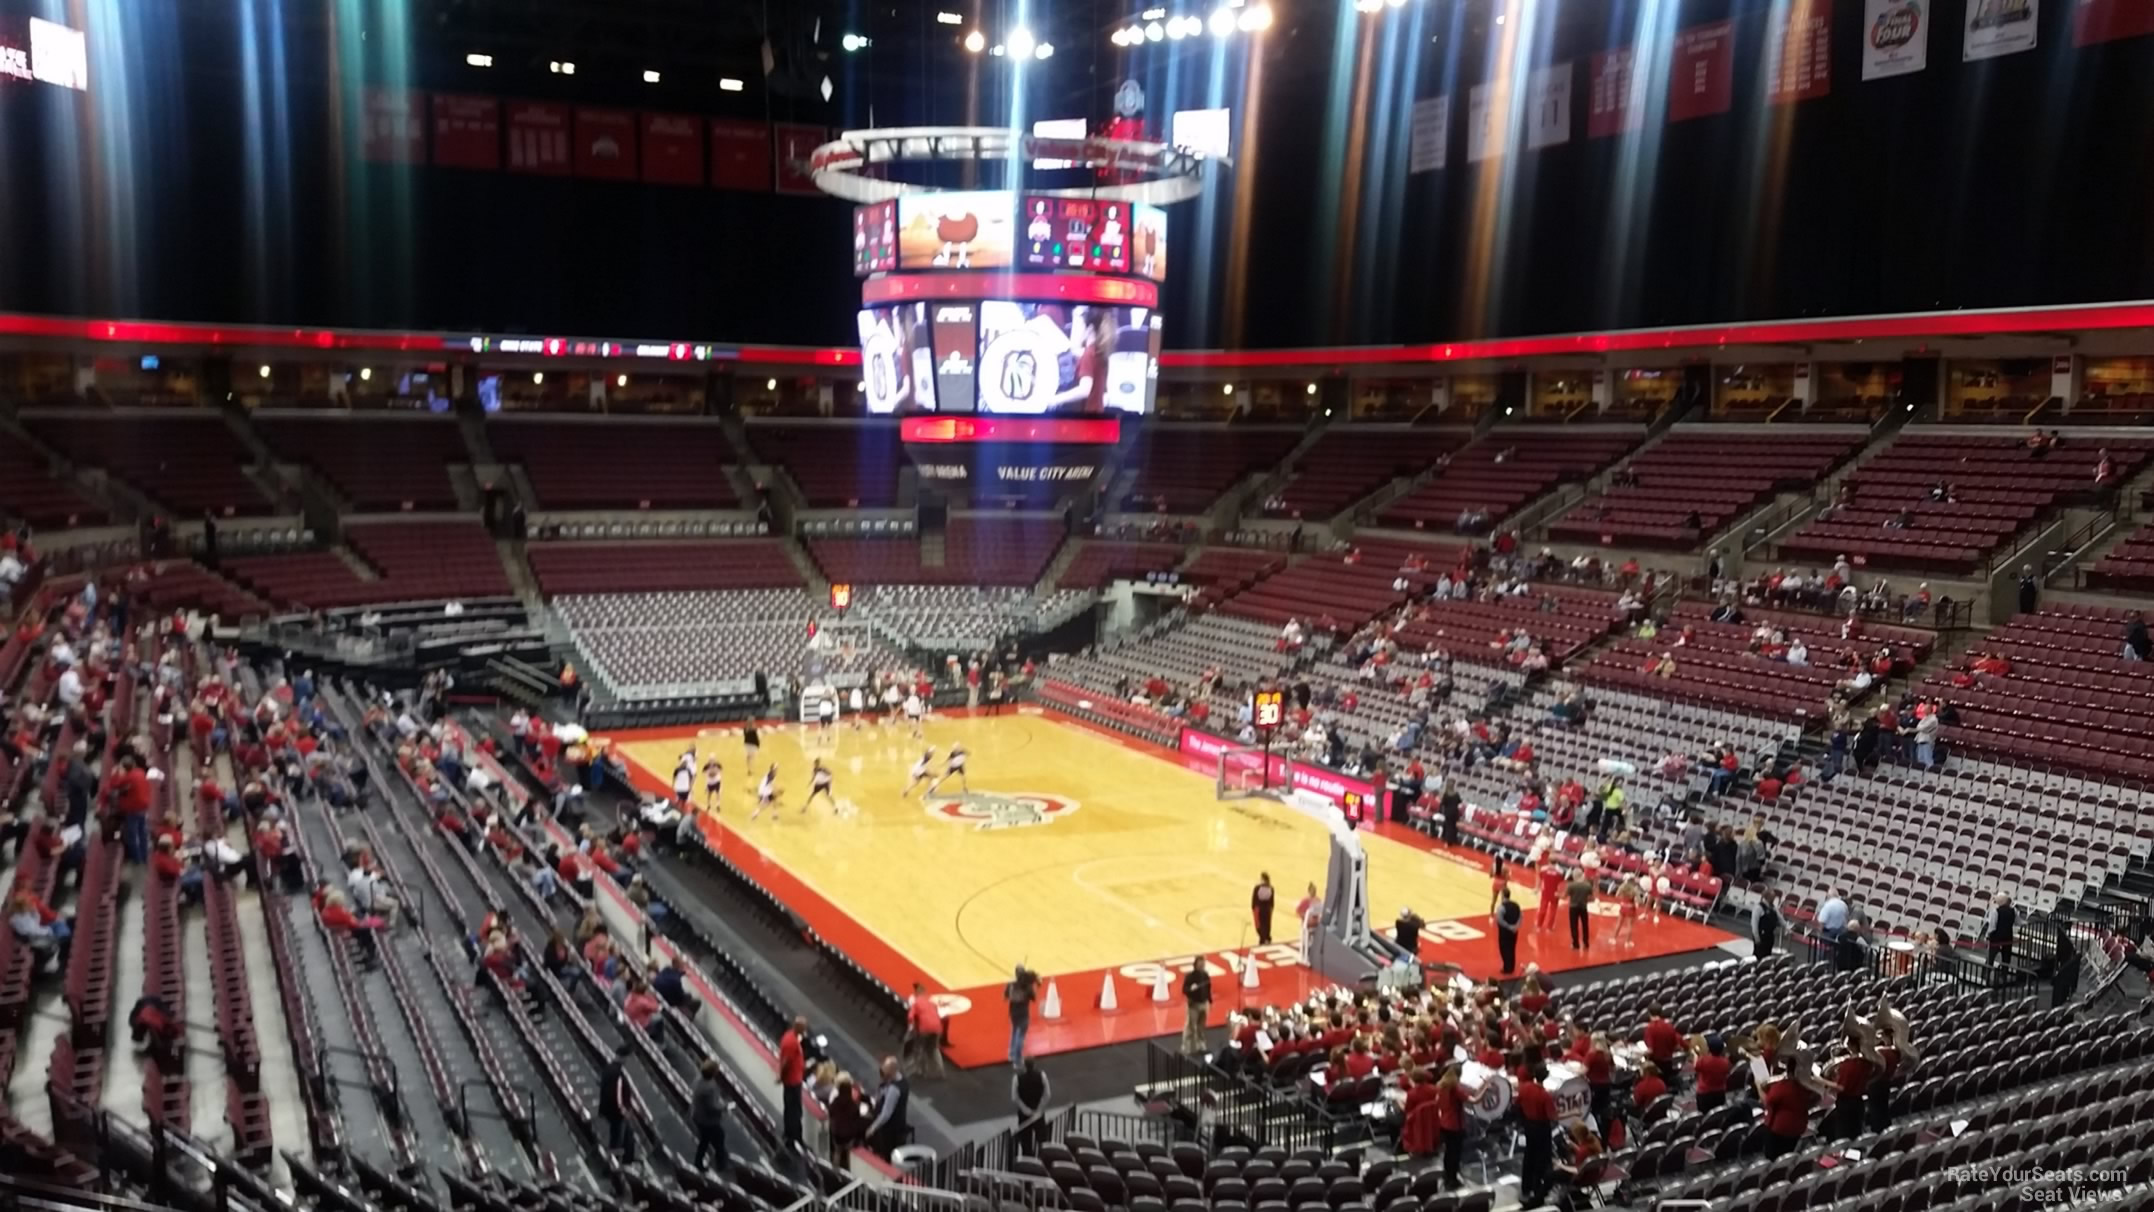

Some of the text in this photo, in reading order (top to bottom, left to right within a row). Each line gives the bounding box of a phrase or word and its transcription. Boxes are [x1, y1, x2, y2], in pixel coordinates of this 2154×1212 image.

[1875, 24, 1912, 44] FOUR
[998, 465, 1095, 481] VALUE CITY ARENA
[1259, 703, 1279, 725] 30
[1309, 776, 1320, 788] no
[1320, 779, 1345, 797] routin
[1556, 1088, 1591, 1113] STATE
